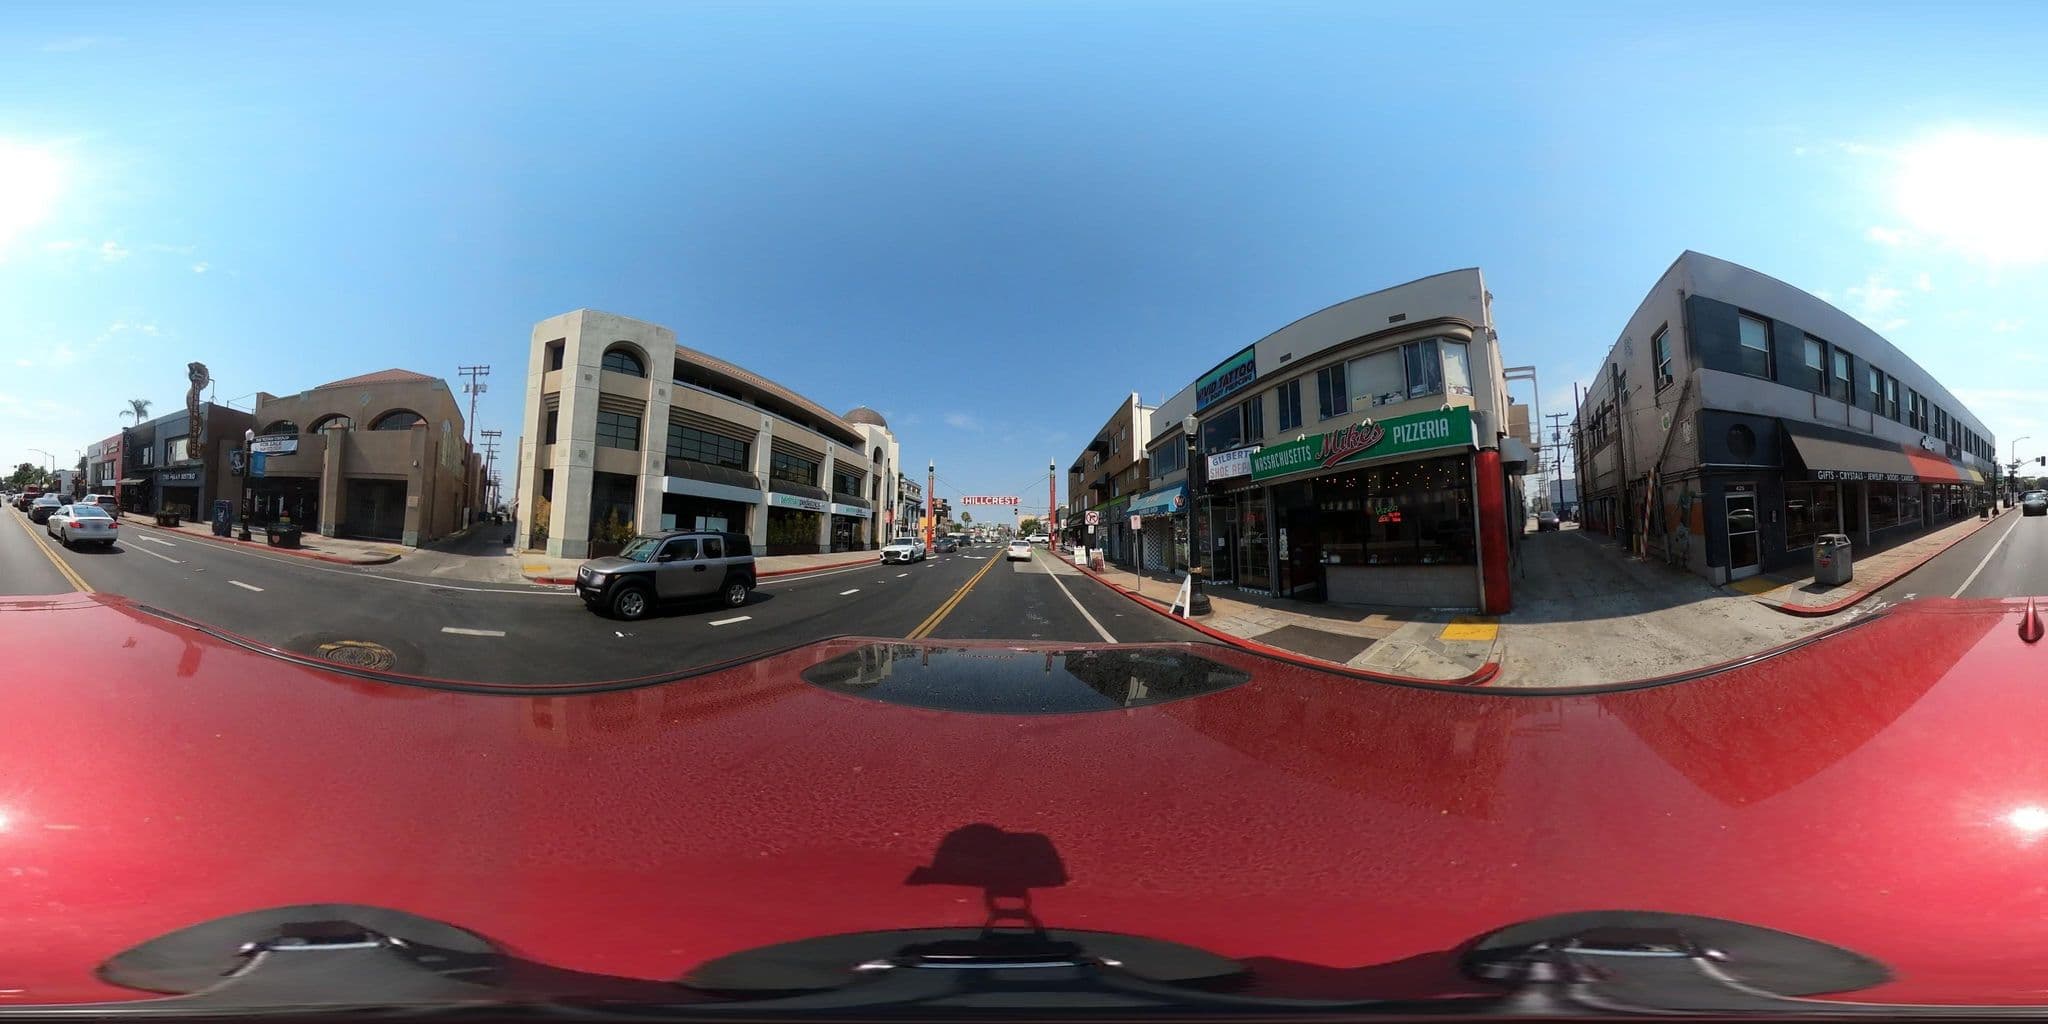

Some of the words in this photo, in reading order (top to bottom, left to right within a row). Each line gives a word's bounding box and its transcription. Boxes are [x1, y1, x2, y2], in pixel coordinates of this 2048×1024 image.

[1254, 445, 1312, 473] MASSACHUSETTS
[1392, 417, 1449, 445] PIZZERIA
[1212, 450, 1251, 466] GILBERT
[1209, 465, 1230, 479] SHOE
[1817, 470, 1835, 480] GIFTS
[1839, 471, 1864, 481] CRYSTALS
